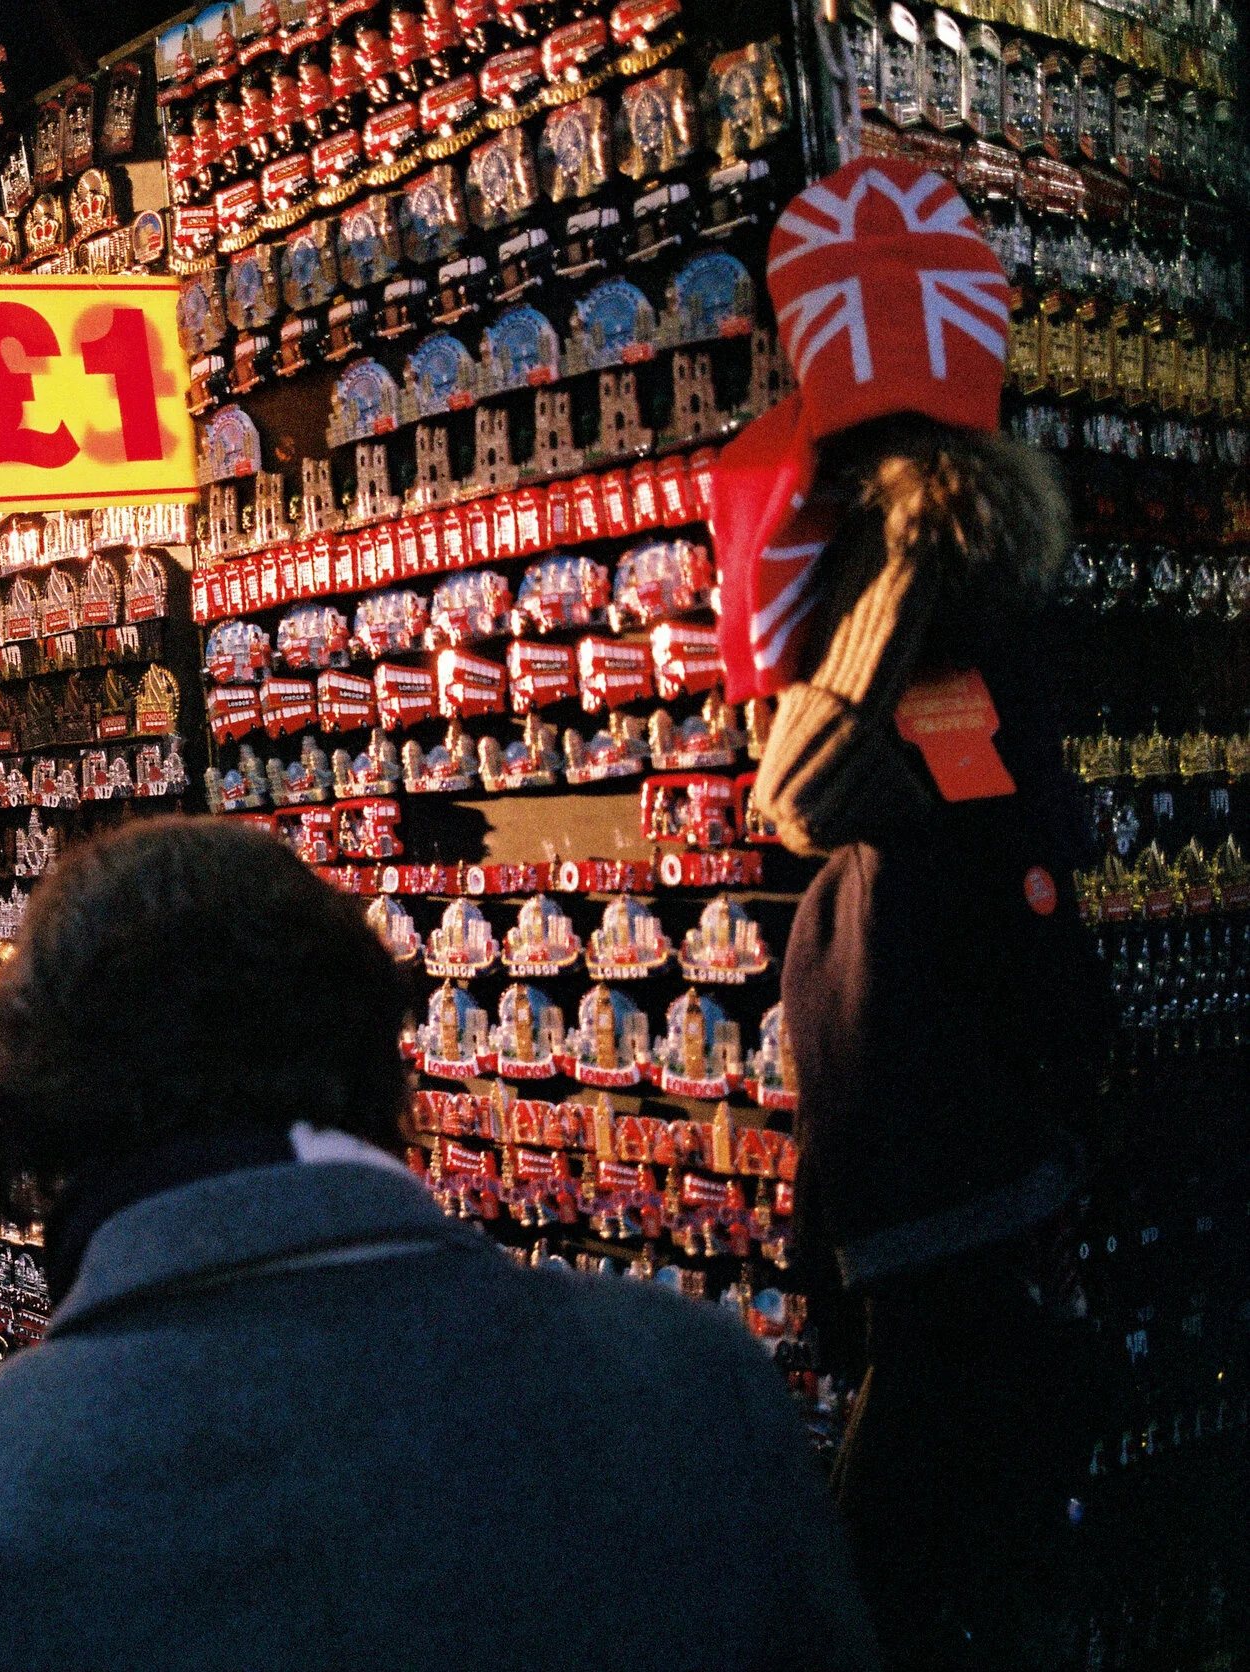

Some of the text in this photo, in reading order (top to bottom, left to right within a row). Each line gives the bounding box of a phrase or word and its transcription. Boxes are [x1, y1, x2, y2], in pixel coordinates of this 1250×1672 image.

[168, 254, 217, 276] LONDON
[142, 712, 168, 722] LONDON
[431, 964, 477, 977] LONDON
[511, 963, 560, 976] LONDON
[597, 966, 649, 979] LONDON
[689, 968, 748, 984] LONDON
[427, 1060, 476, 1078] LONDON
[501, 1062, 553, 1079] LONDON
[579, 1070, 637, 1086] LONDON
[666, 1079, 726, 1098] LONDON
